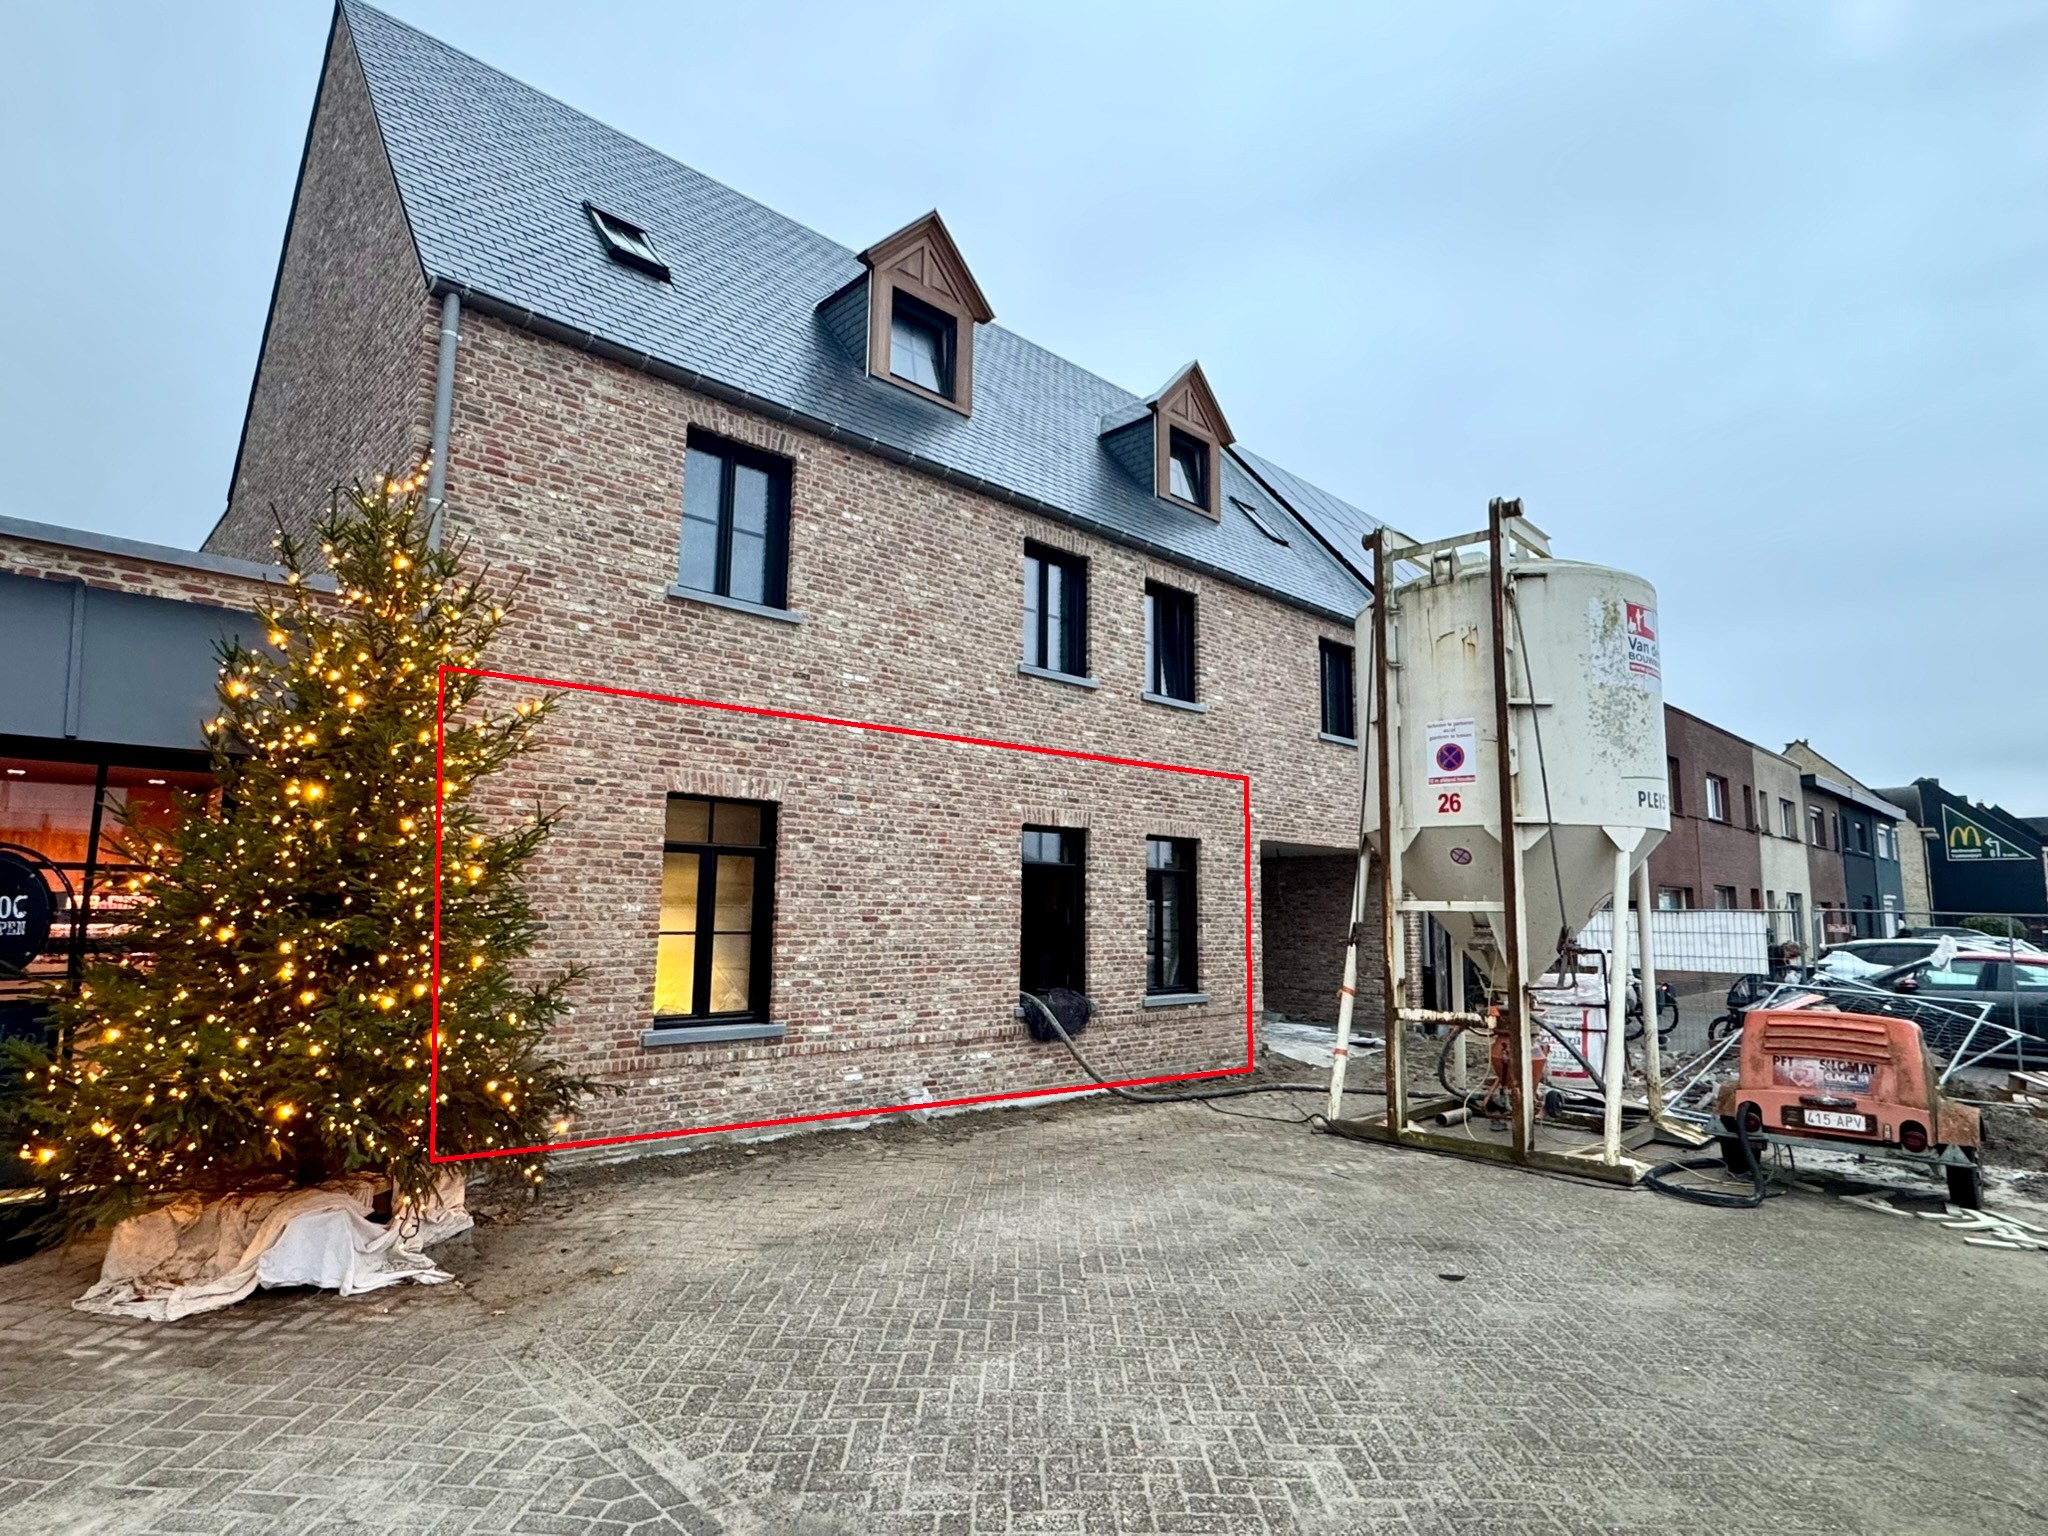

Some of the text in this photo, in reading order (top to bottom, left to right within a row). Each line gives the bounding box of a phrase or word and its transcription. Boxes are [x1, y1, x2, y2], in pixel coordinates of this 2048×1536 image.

[1628, 636, 1650, 654] Van
[1438, 793, 1461, 813] 26
[1773, 1055, 1877, 1075] PFT SILOMAT
